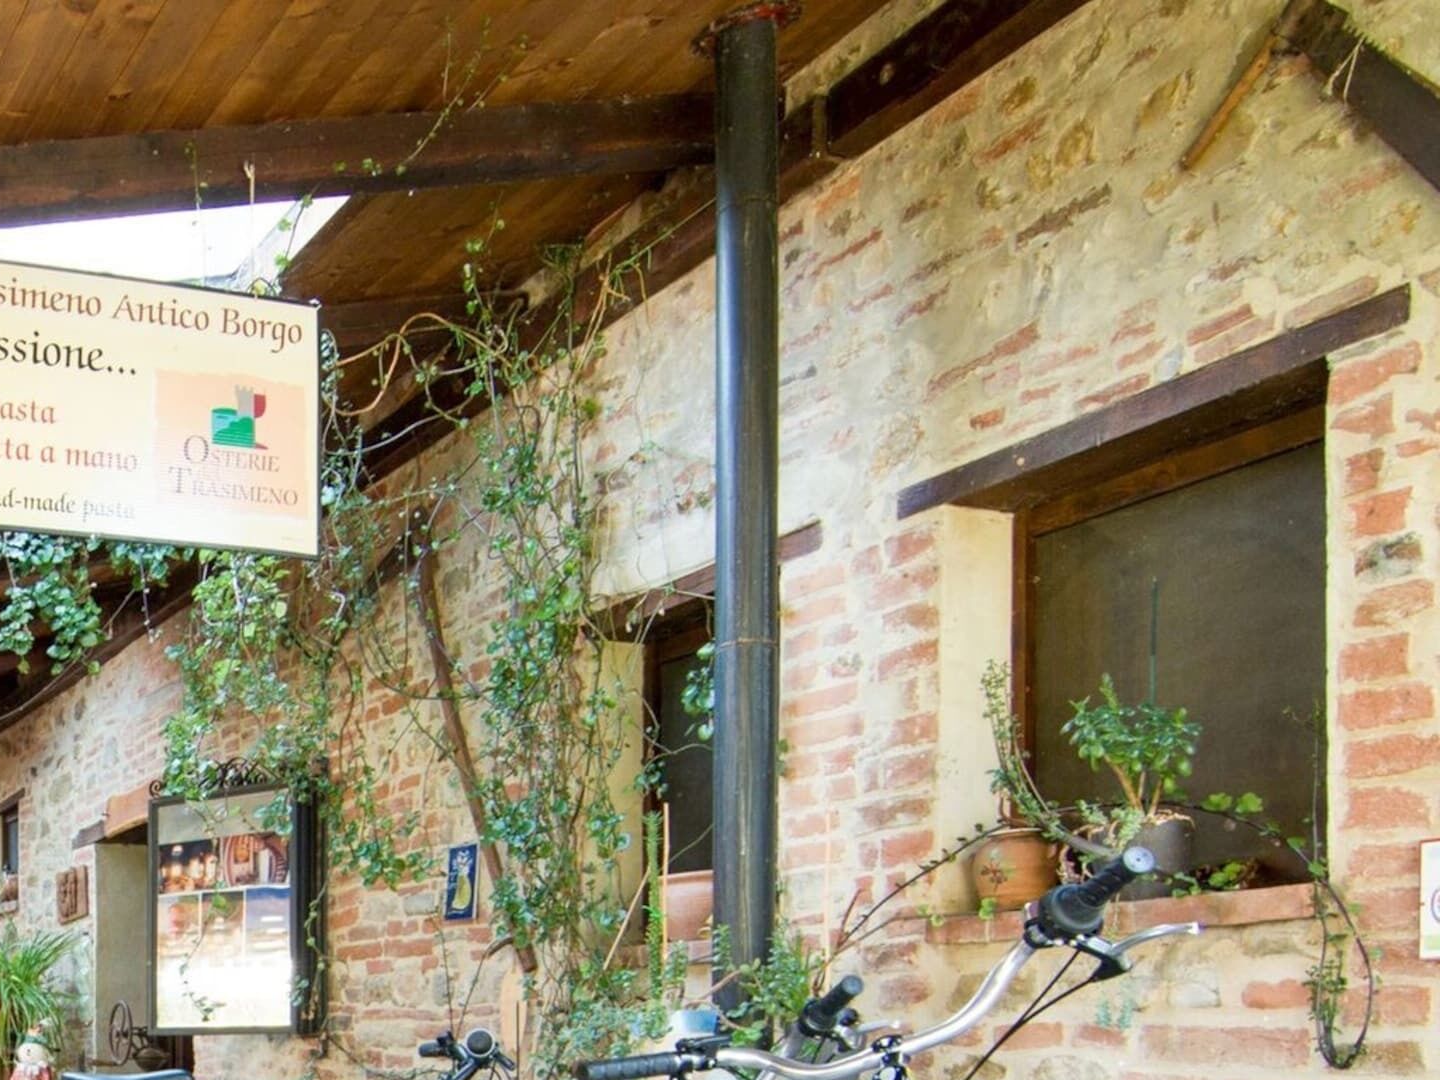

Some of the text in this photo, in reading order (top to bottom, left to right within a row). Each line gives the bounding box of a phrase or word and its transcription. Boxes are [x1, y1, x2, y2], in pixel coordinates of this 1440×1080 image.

[111, 294, 210, 331] Antico
[221, 307, 303, 354] Borgo
[40, 444, 56, 464] a
[65, 446, 139, 472] mano
[183, 434, 281, 473] OSTERIE
[168, 466, 299, 507] TRASIMENO
[82, 499, 136, 523] pasta
